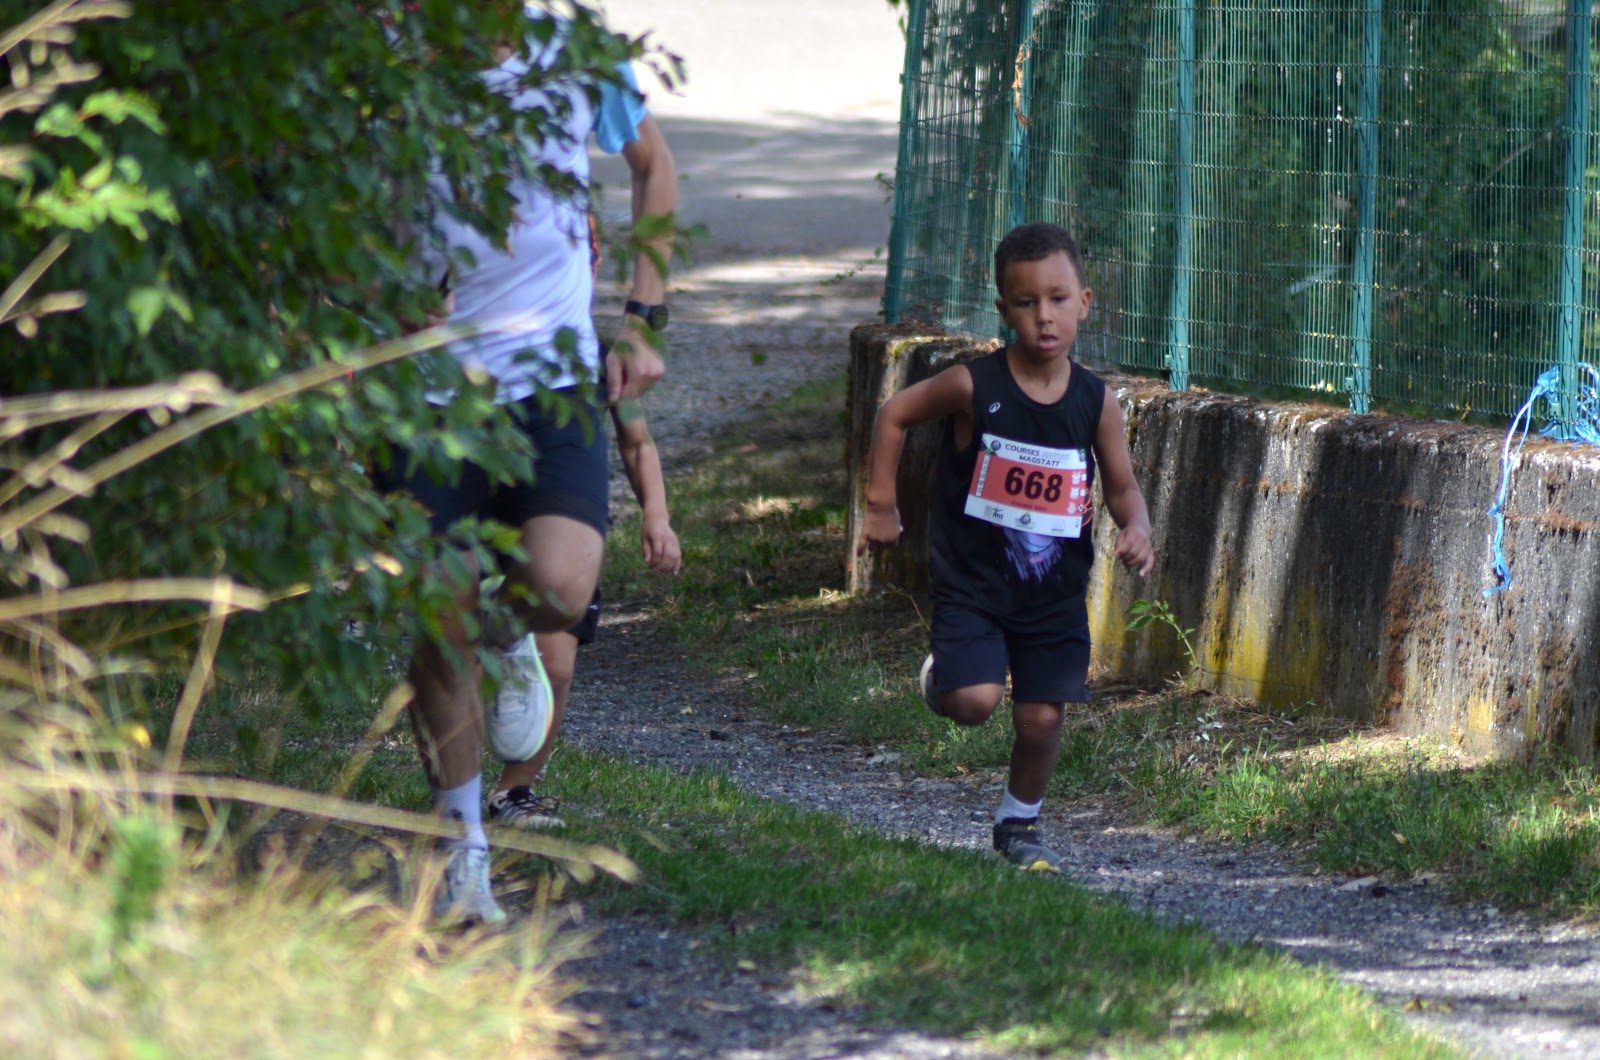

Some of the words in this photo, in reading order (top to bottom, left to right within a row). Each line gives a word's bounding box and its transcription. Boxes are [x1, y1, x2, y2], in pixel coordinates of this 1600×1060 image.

[1005, 444, 1040, 456] COURSES
[1019, 455, 1061, 467] MAGSTATT
[1004, 466, 1063, 503] 668
